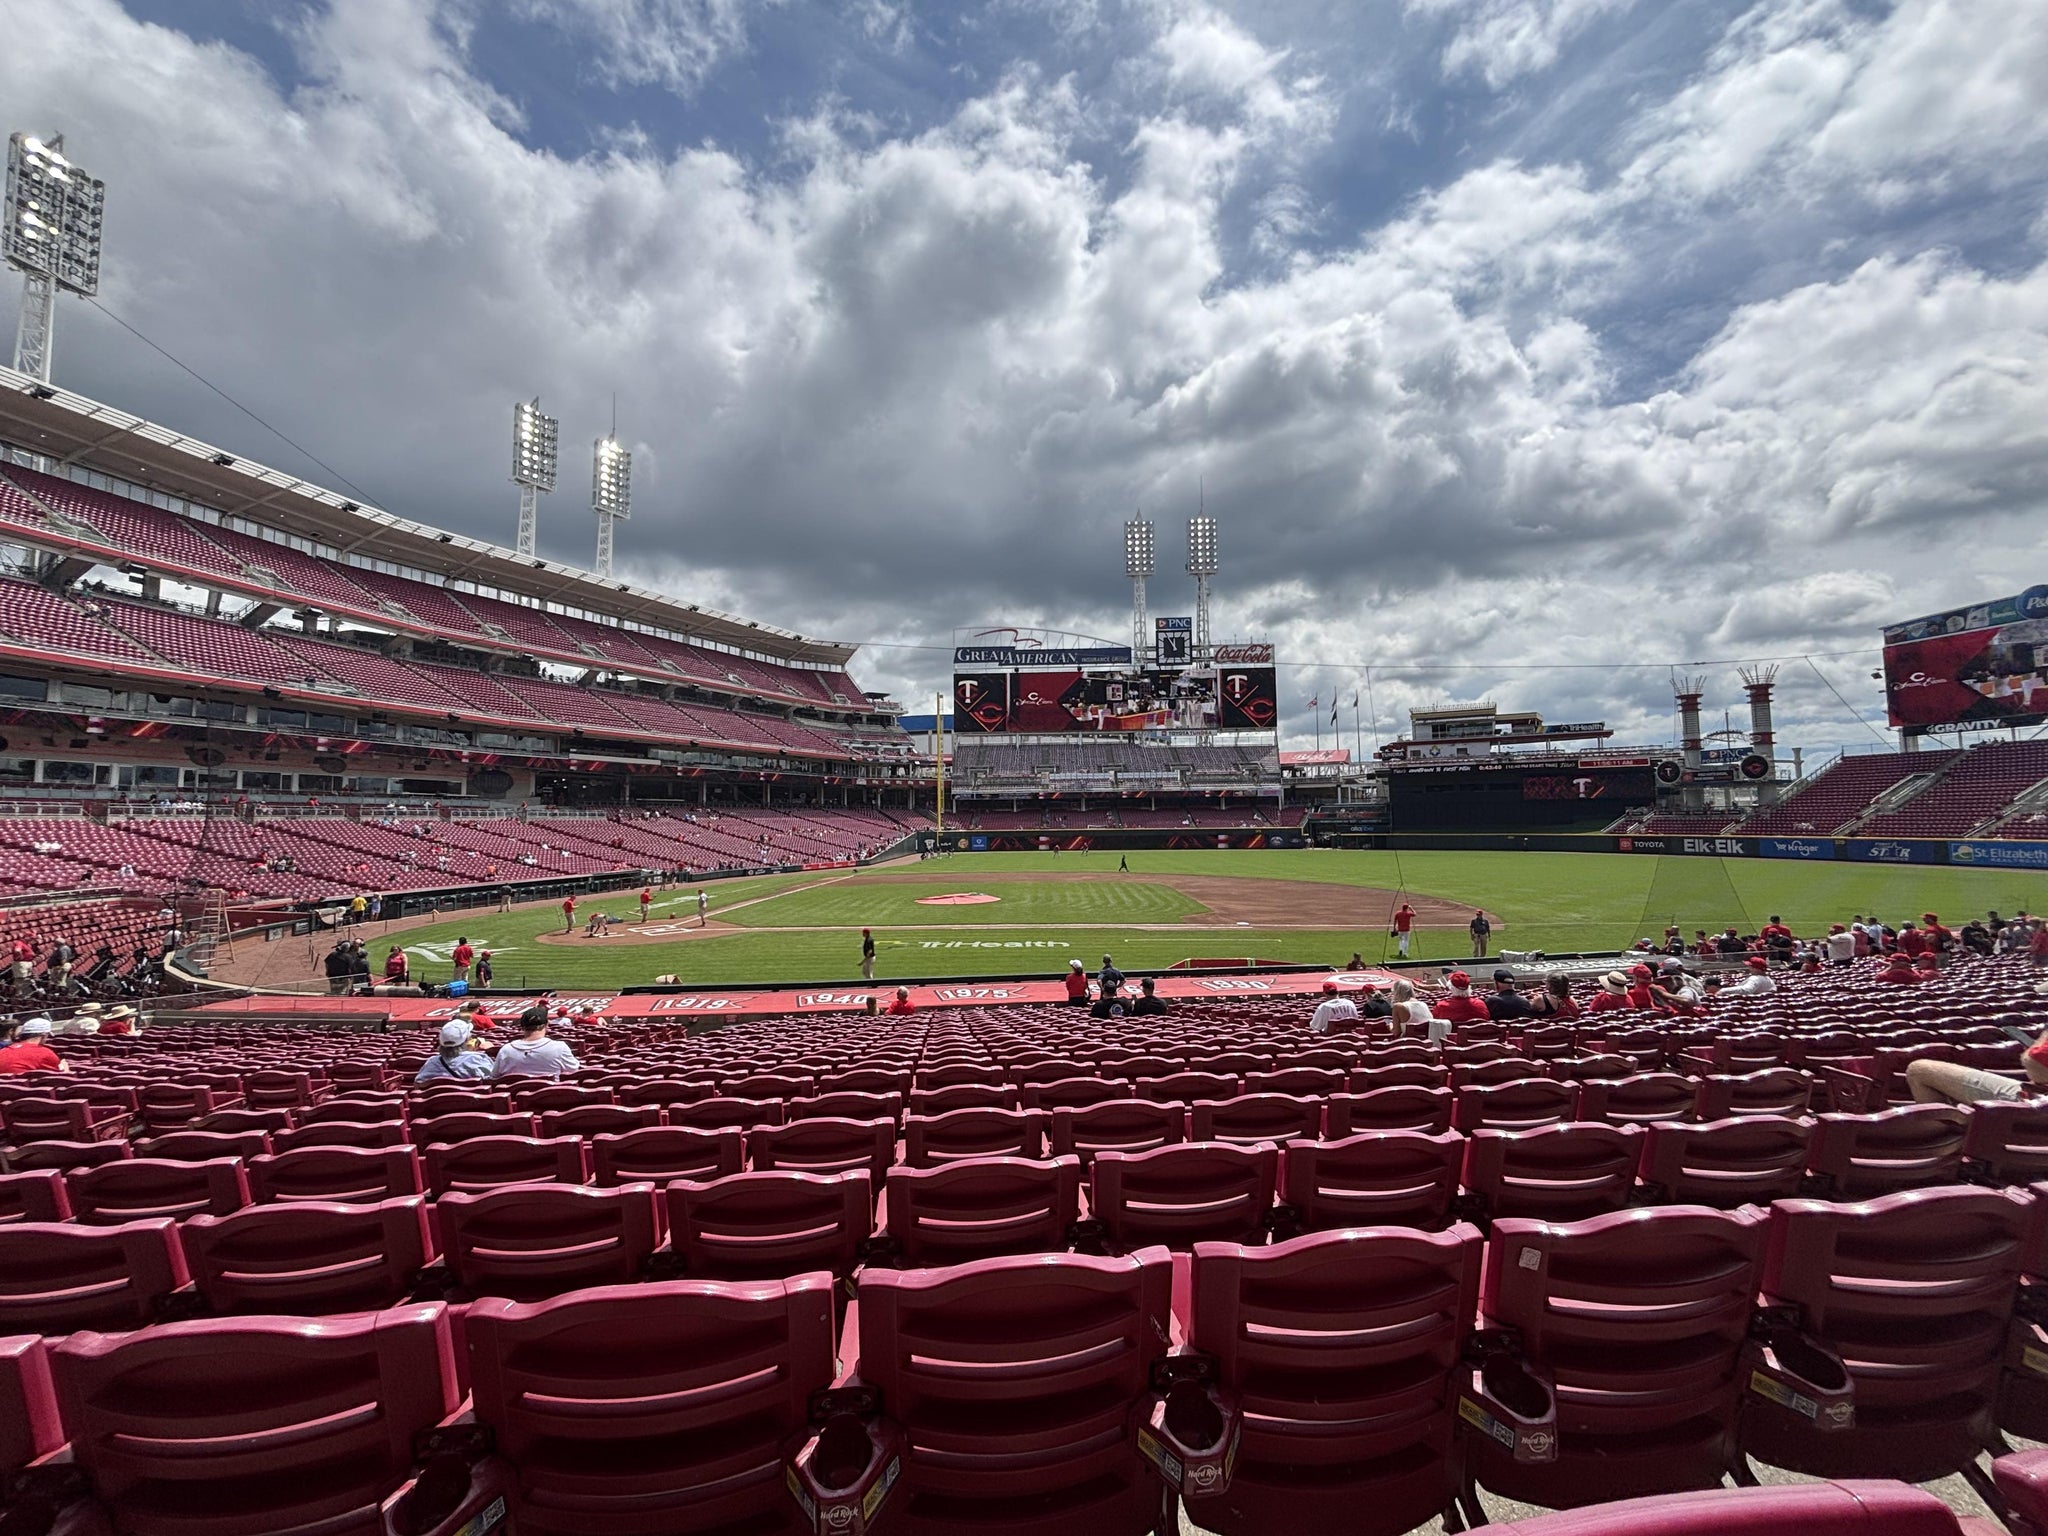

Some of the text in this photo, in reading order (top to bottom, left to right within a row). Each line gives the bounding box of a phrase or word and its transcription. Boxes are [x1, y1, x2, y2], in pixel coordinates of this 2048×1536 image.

[2026, 596, 2048, 610] P&
[1168, 618, 1191, 628] PNC
[957, 648, 1004, 662] GREAT
[1002, 651, 1077, 664] AMERICAN
[1214, 644, 1273, 664] Coca-Cola
[1934, 719, 2001, 733] GRAVITY
[1719, 749, 1744, 758] PNC
[1634, 841, 1665, 849] TOYOTA
[1787, 840, 1819, 856] Kroger
[1990, 848, 2048, 860] Elizabeth
[918, 941, 1071, 949] TriHealth
[803, 994, 869, 1005] 1940
[943, 989, 1010, 999] 1975
[547, 998, 613, 1007] ERIES
[663, 998, 729, 1010] 1919
[1521, 1436, 1539, 1444] Hard
[1187, 1467, 1222, 1478] Hard Rock
[820, 1507, 859, 1519] Hard Rock
